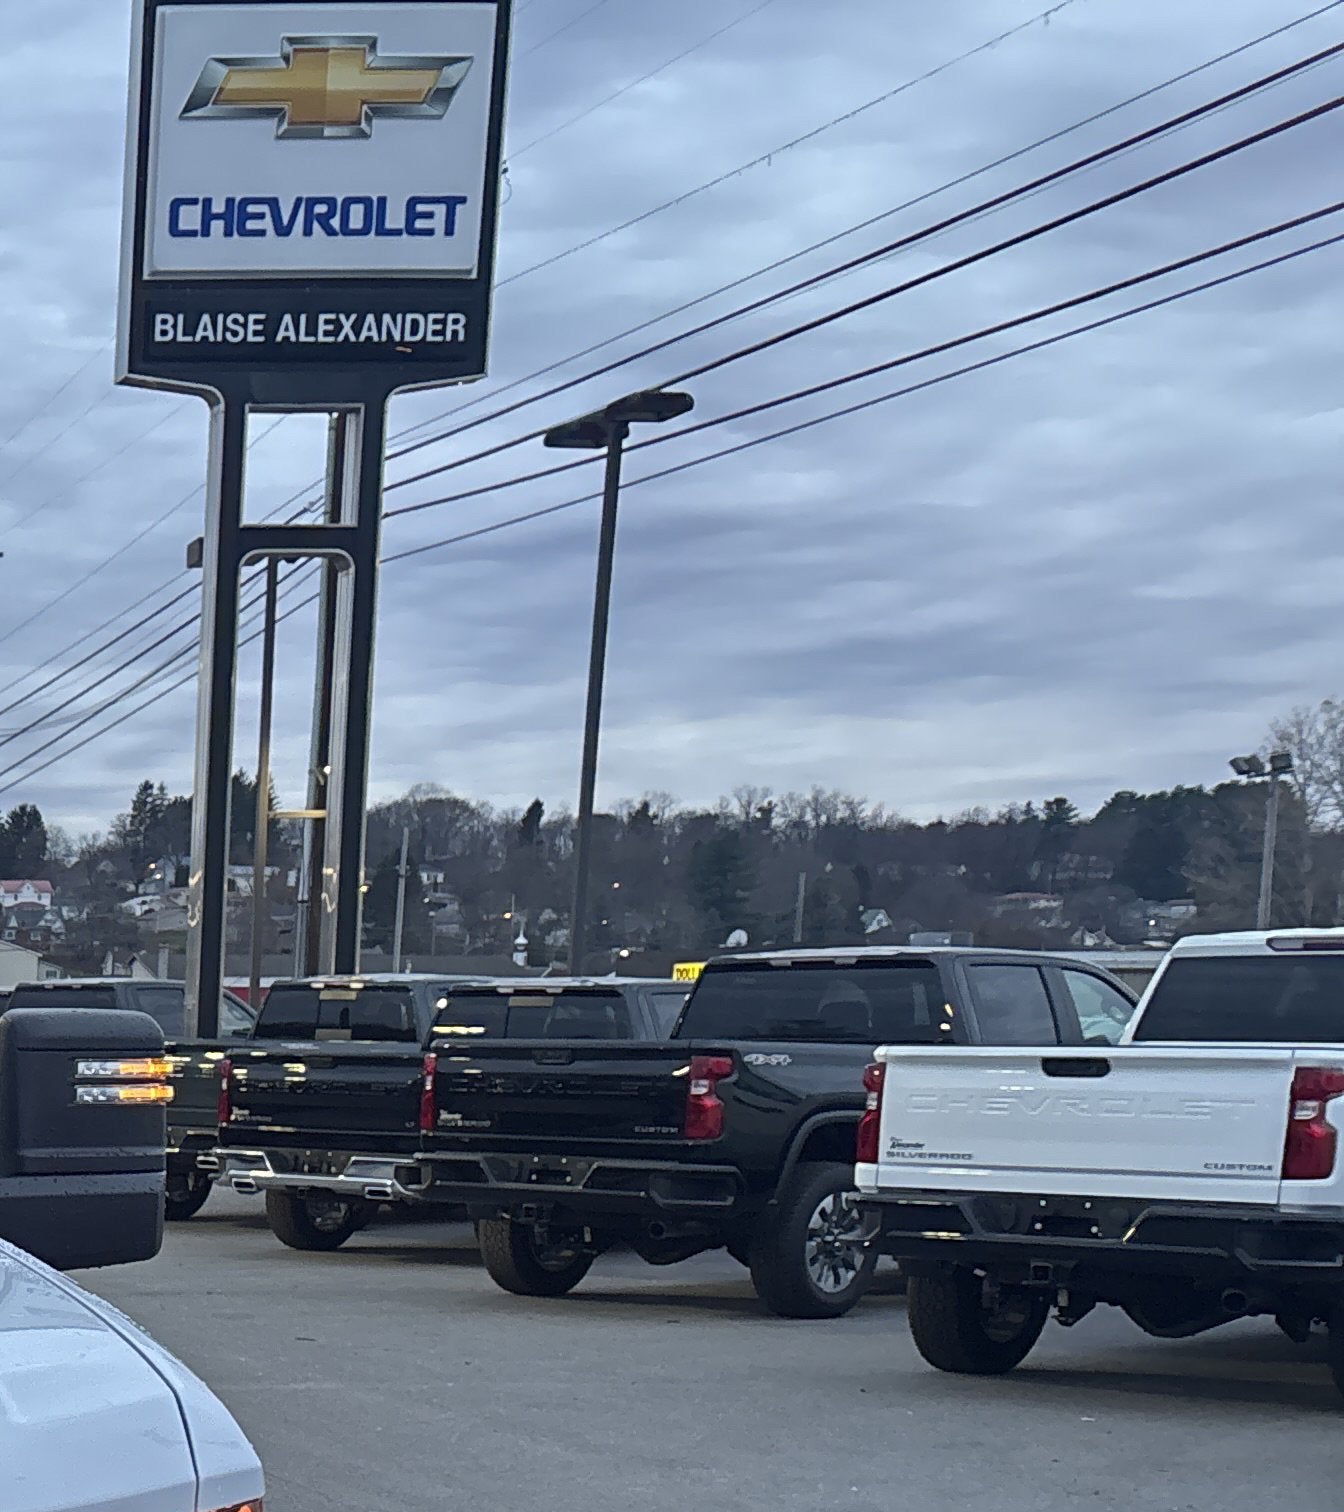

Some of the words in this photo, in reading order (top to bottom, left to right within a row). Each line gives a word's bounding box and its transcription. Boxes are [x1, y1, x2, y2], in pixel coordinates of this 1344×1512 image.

[168, 195, 467, 238] CHEVROLET
[153, 312, 267, 343] BLAISE
[274, 312, 467, 343] ALEXANDER
[676, 967, 703, 981] DOLL
[907, 1094, 1256, 1119] CHEVROLET
[885, 1150, 973, 1160] SILVERADO
[1203, 1162, 1273, 1171] CUSTOM
